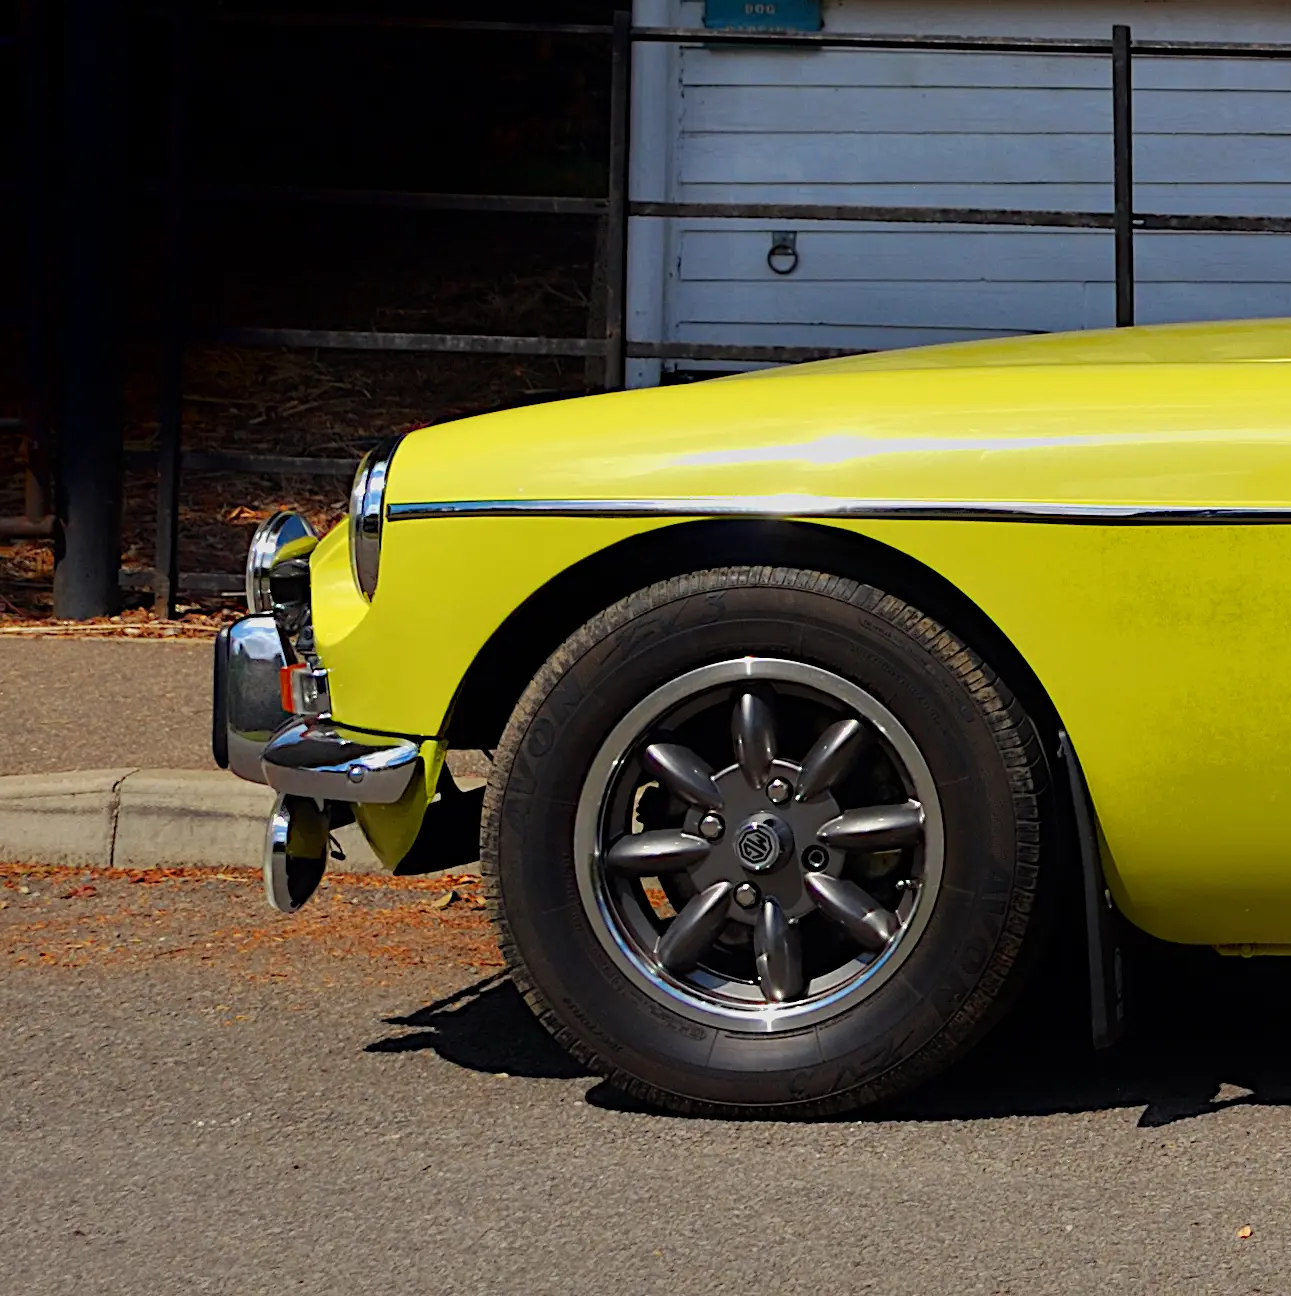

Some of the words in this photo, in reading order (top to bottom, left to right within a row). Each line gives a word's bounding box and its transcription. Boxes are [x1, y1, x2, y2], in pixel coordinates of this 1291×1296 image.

[745, 4, 776, 14] DOG
[505, 676, 585, 842] AVON
[741, 833, 770, 860] MG
